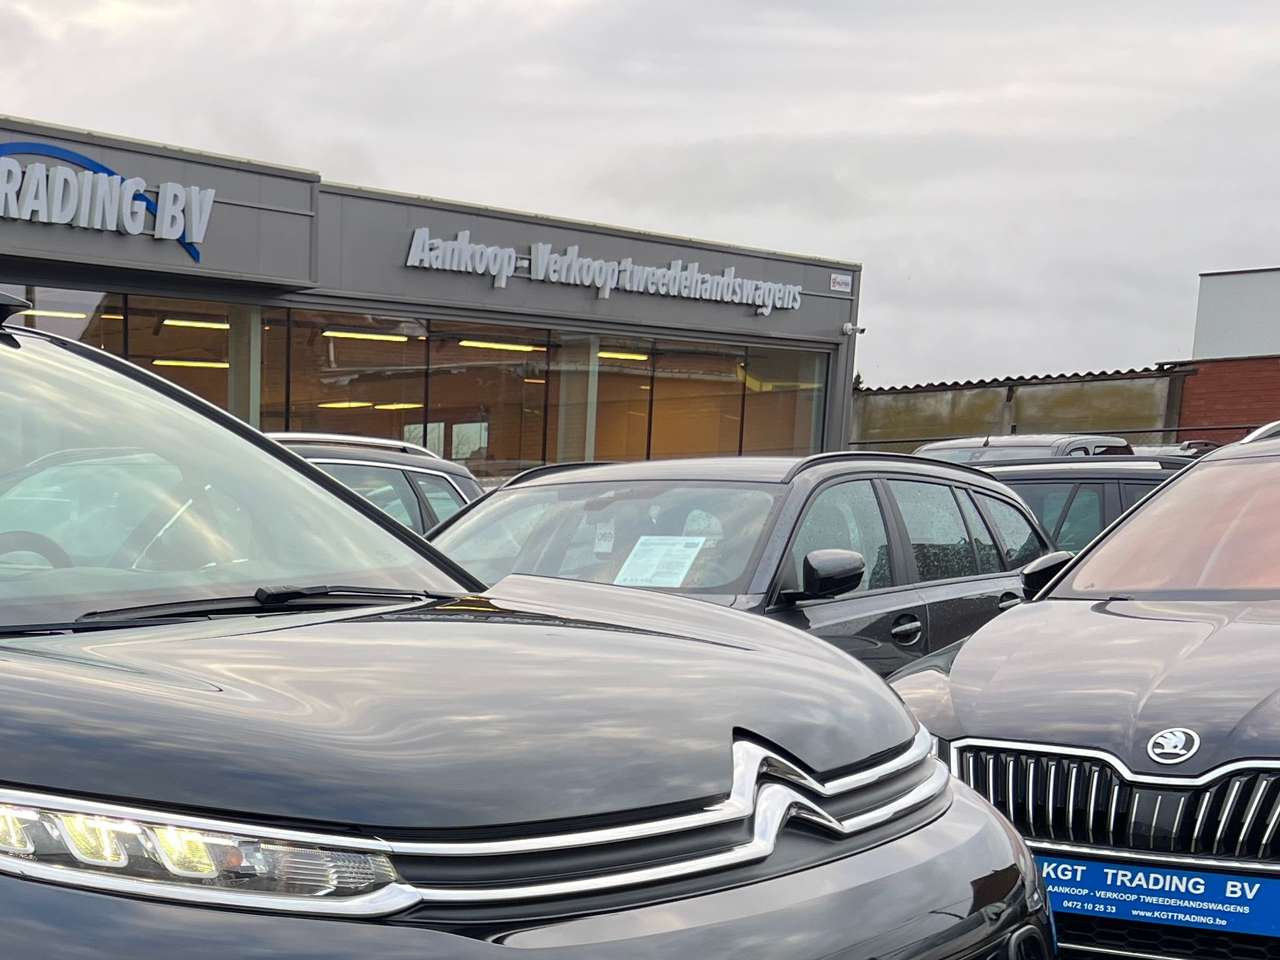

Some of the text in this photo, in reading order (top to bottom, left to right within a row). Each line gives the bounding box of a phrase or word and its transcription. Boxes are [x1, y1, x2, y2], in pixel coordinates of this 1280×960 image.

[154, 182, 216, 243] BV
[406, 227, 516, 288] Aankoop
[531, 242, 619, 299] Verkoop
[619, 257, 803, 316] tweedehandswagens
[1042, 862, 1260, 899] KGT TRADING BV
[1047, 885, 1088, 896] AANKOOP
[1095, 890, 1137, 901] VERKOOP
[1139, 895, 1250, 914] TWEEDEHANDSWAGENS
[1063, 900, 1082, 909] 0472
[1084, 902, 1093, 910] 10
[1106, 905, 1116, 913] 33
[1132, 909, 1227, 926] www.KGTTRADING.be
